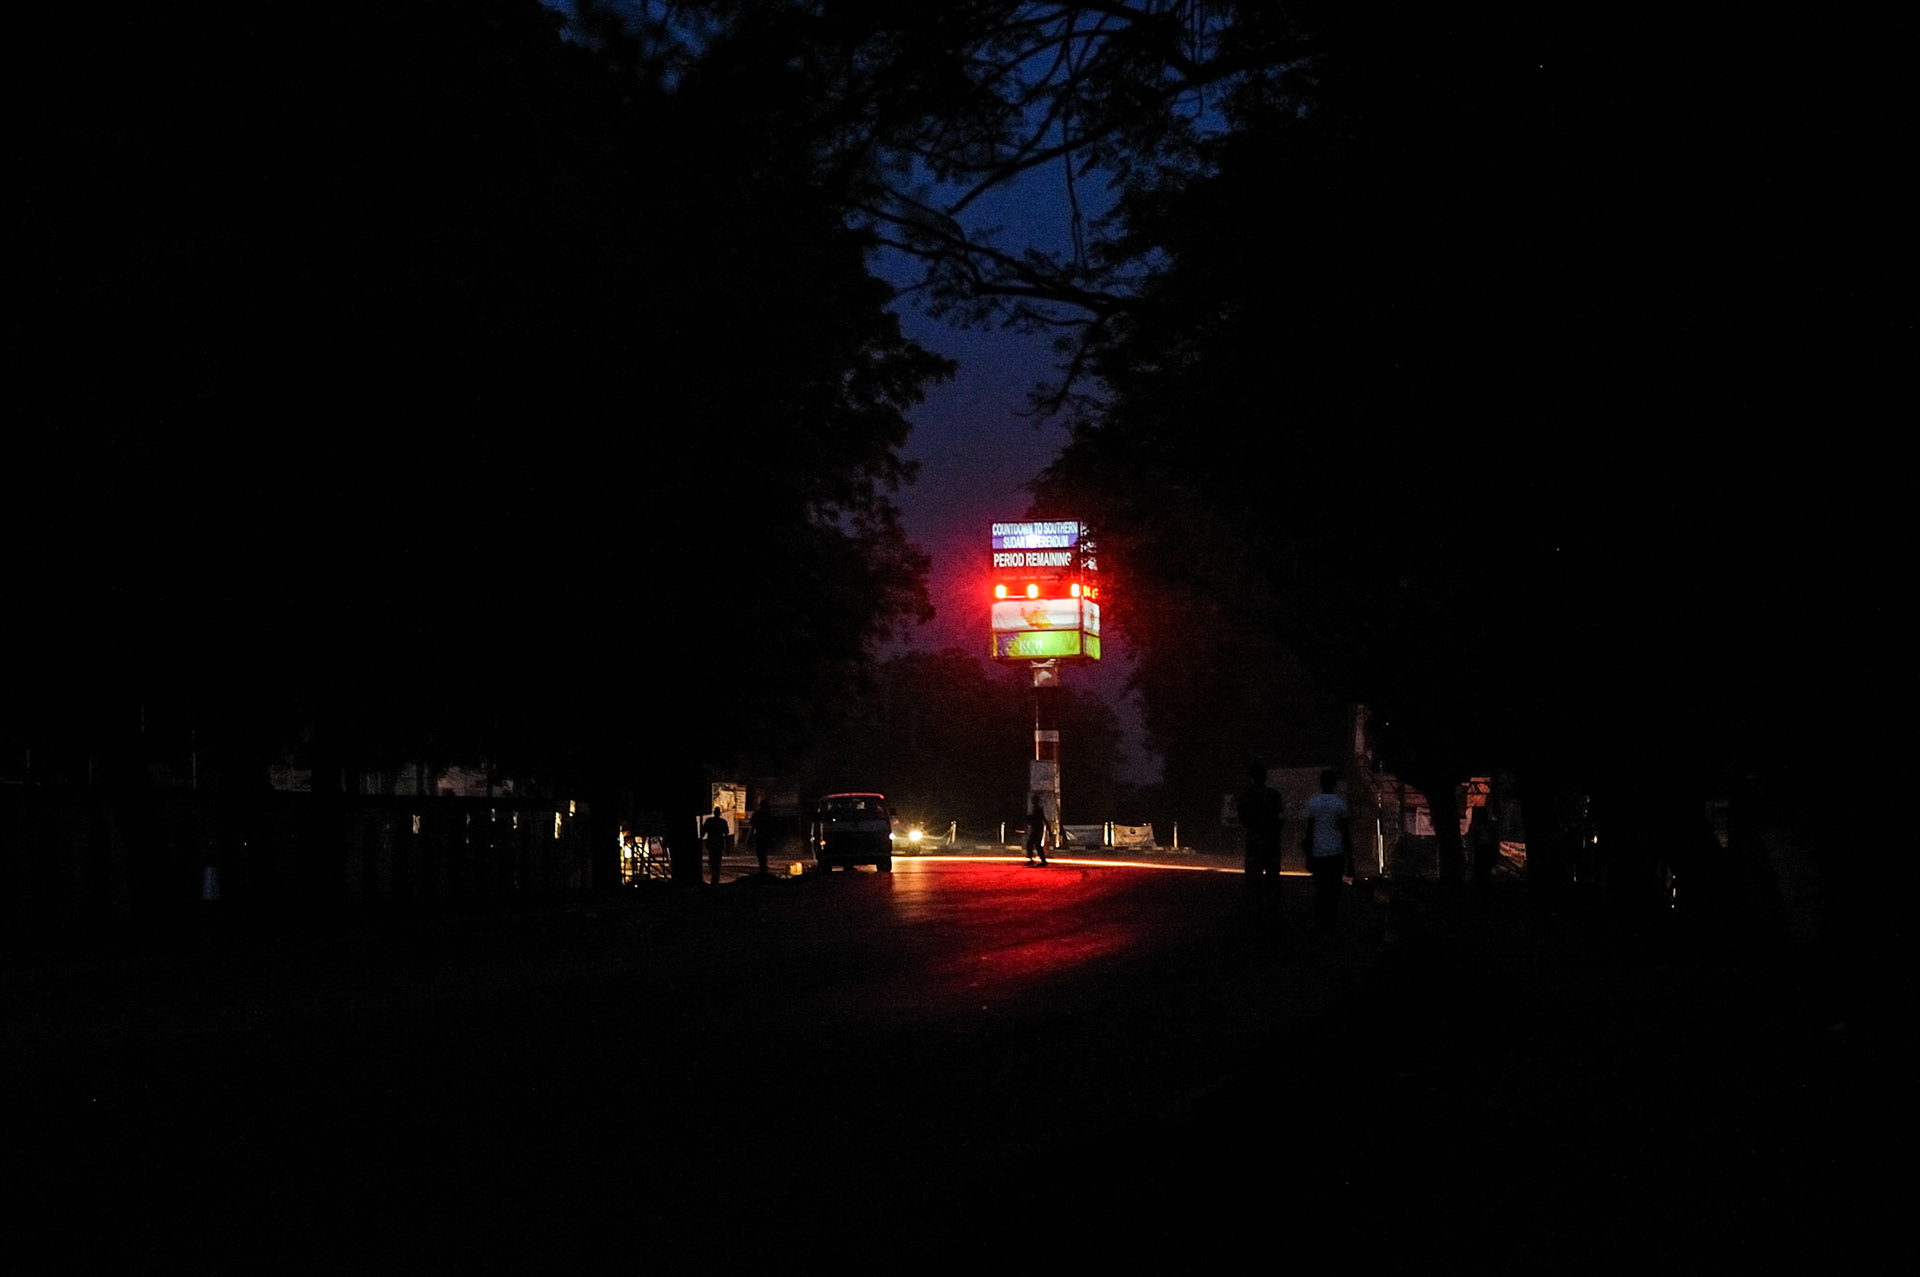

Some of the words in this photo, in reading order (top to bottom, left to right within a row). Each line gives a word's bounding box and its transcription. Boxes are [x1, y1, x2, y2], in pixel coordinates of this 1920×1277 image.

[992, 523, 1033, 536] COUNTDOWN
[1034, 522, 1043, 535] TO
[1043, 521, 1078, 534] SOUTHERN
[1003, 536, 1025, 549] SUDAN
[1025, 535, 1069, 548] FERENDUM
[993, 553, 1024, 567] PERIOD
[1026, 552, 1071, 566] REMAINING
